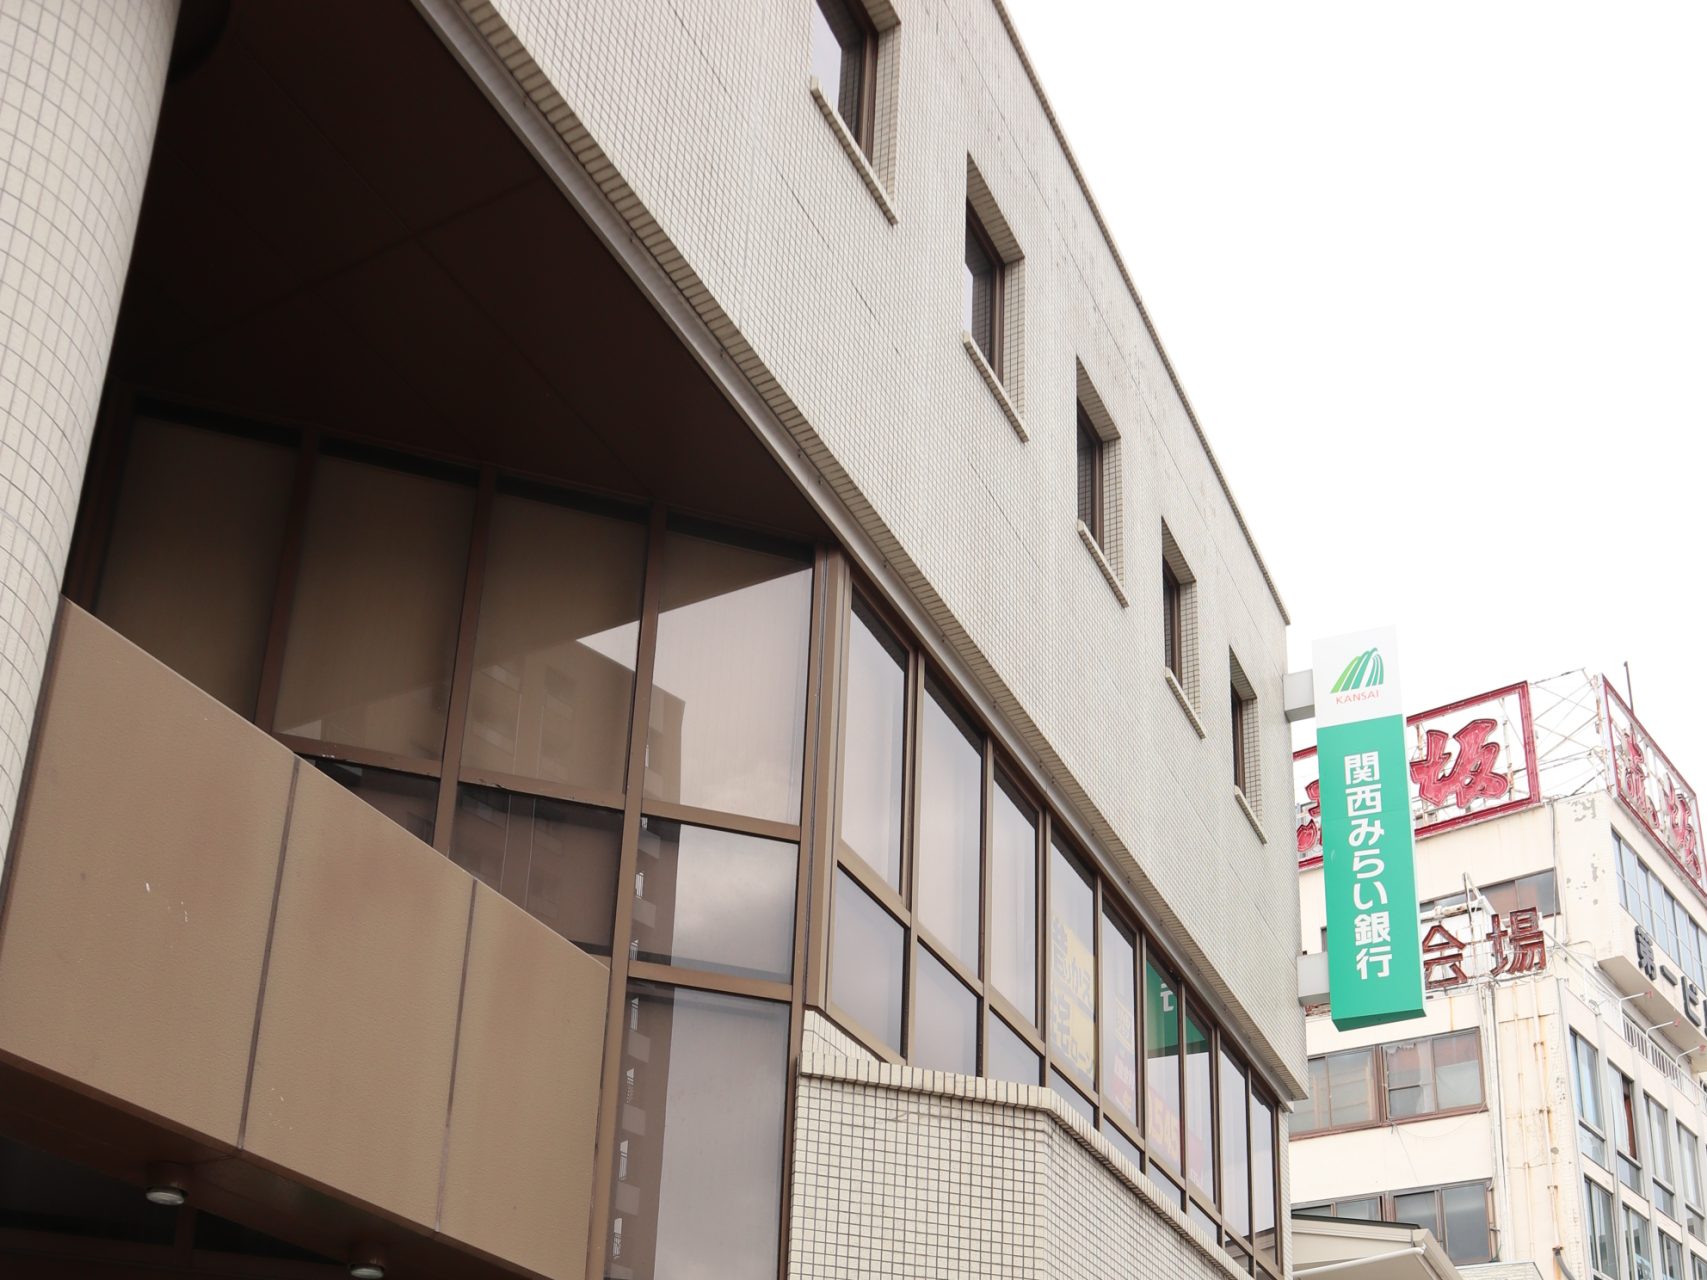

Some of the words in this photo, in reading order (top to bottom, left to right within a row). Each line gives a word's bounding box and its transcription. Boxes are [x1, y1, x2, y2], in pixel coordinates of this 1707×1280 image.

[1336, 690, 1380, 705] KANSAI
[1343, 751, 1393, 981] 関西みらい銀行
